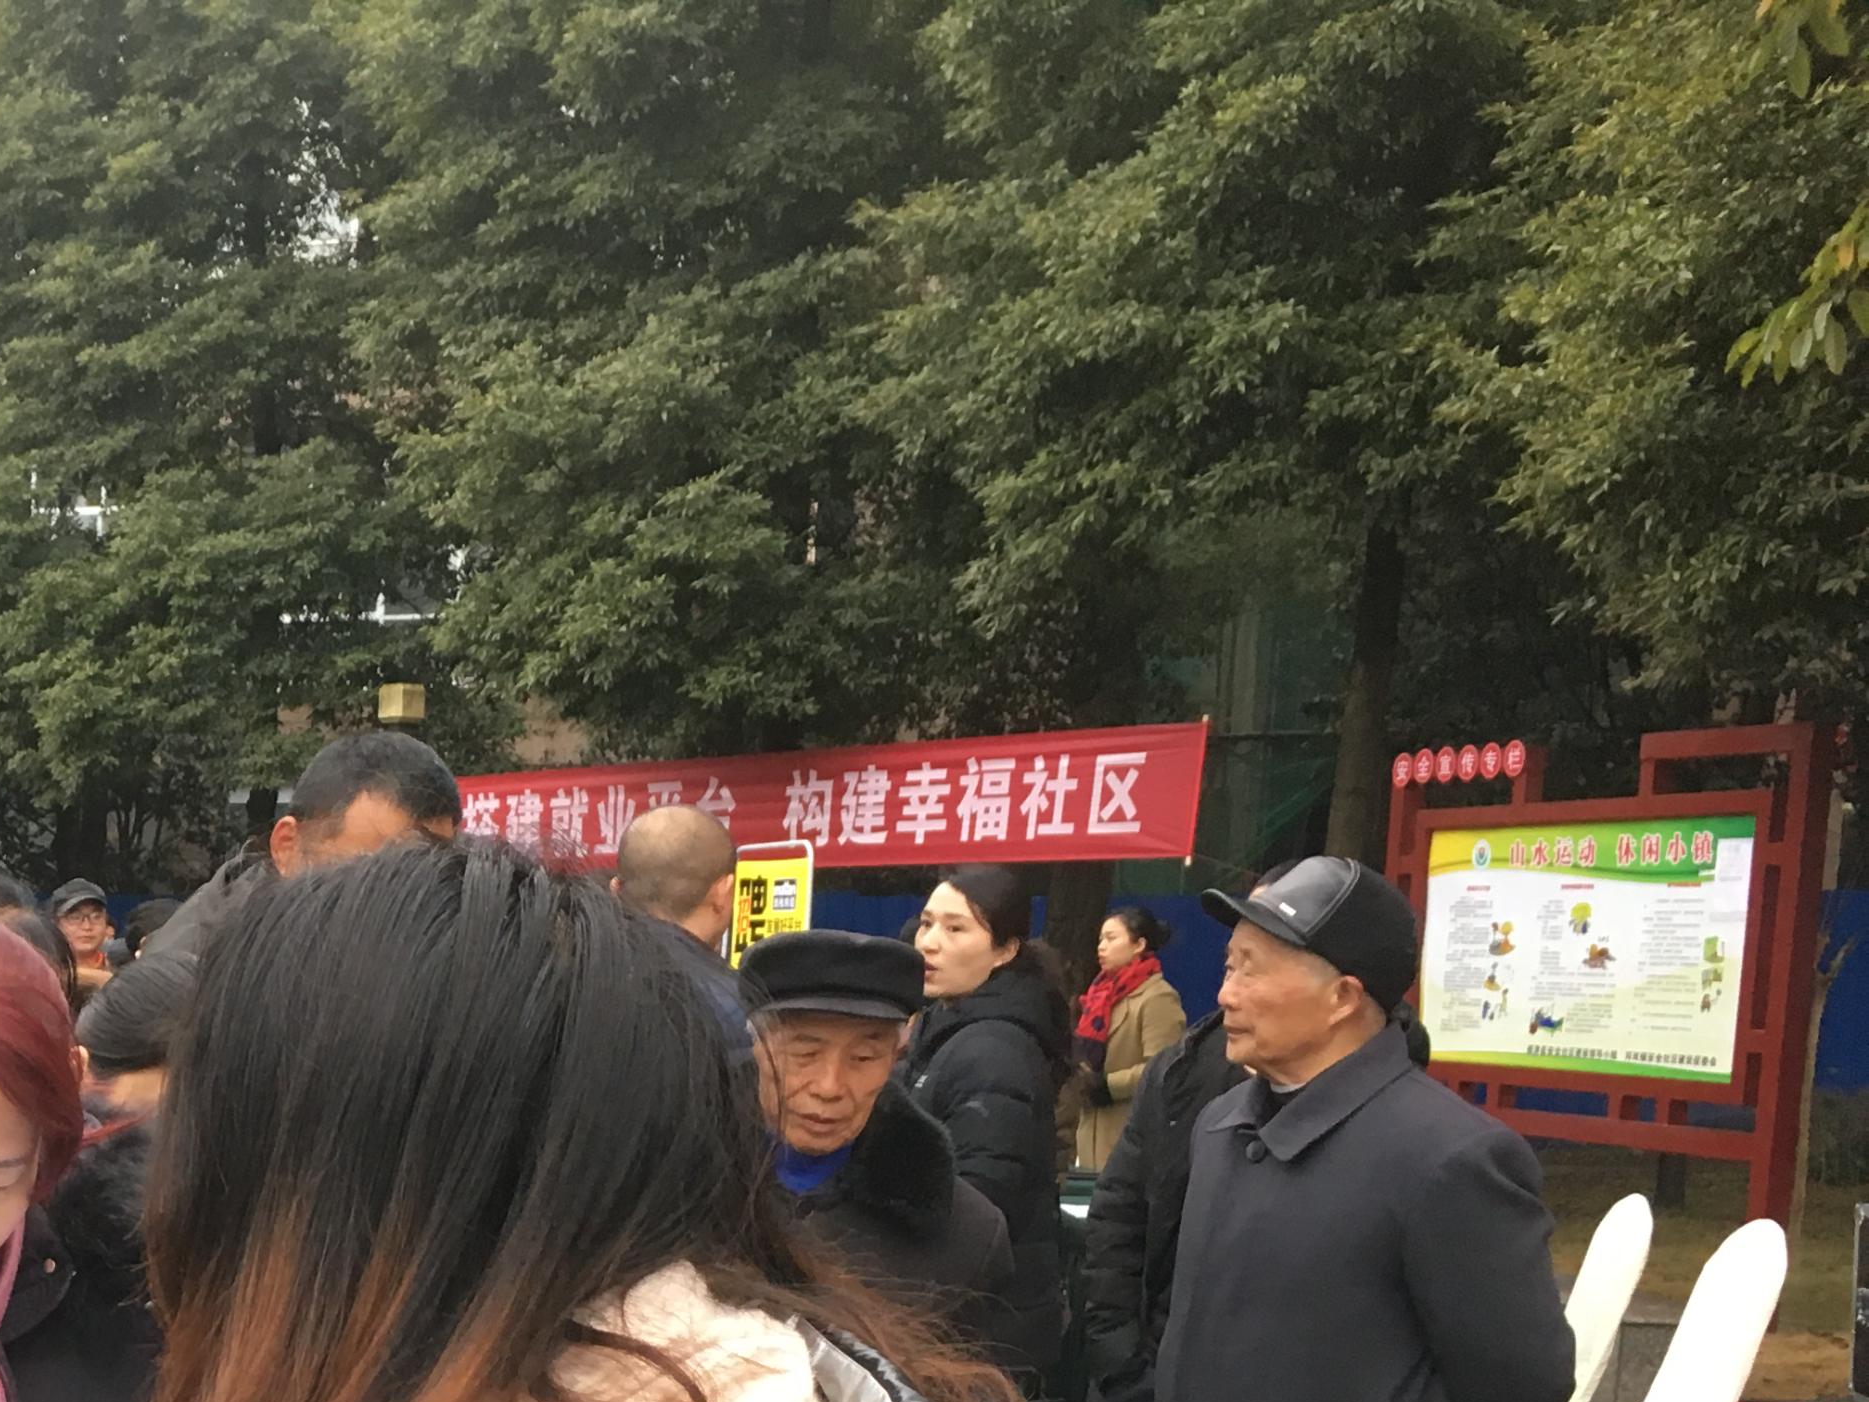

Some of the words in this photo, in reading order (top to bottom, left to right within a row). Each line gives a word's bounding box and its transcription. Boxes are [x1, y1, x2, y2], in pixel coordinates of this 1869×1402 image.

[1395, 747, 1523, 781] 安全宣传专栏
[782, 751, 1147, 847] 构建幸福社区
[1509, 836, 1598, 868] 山水运动
[1616, 830, 1714, 867] 休闲小镇
